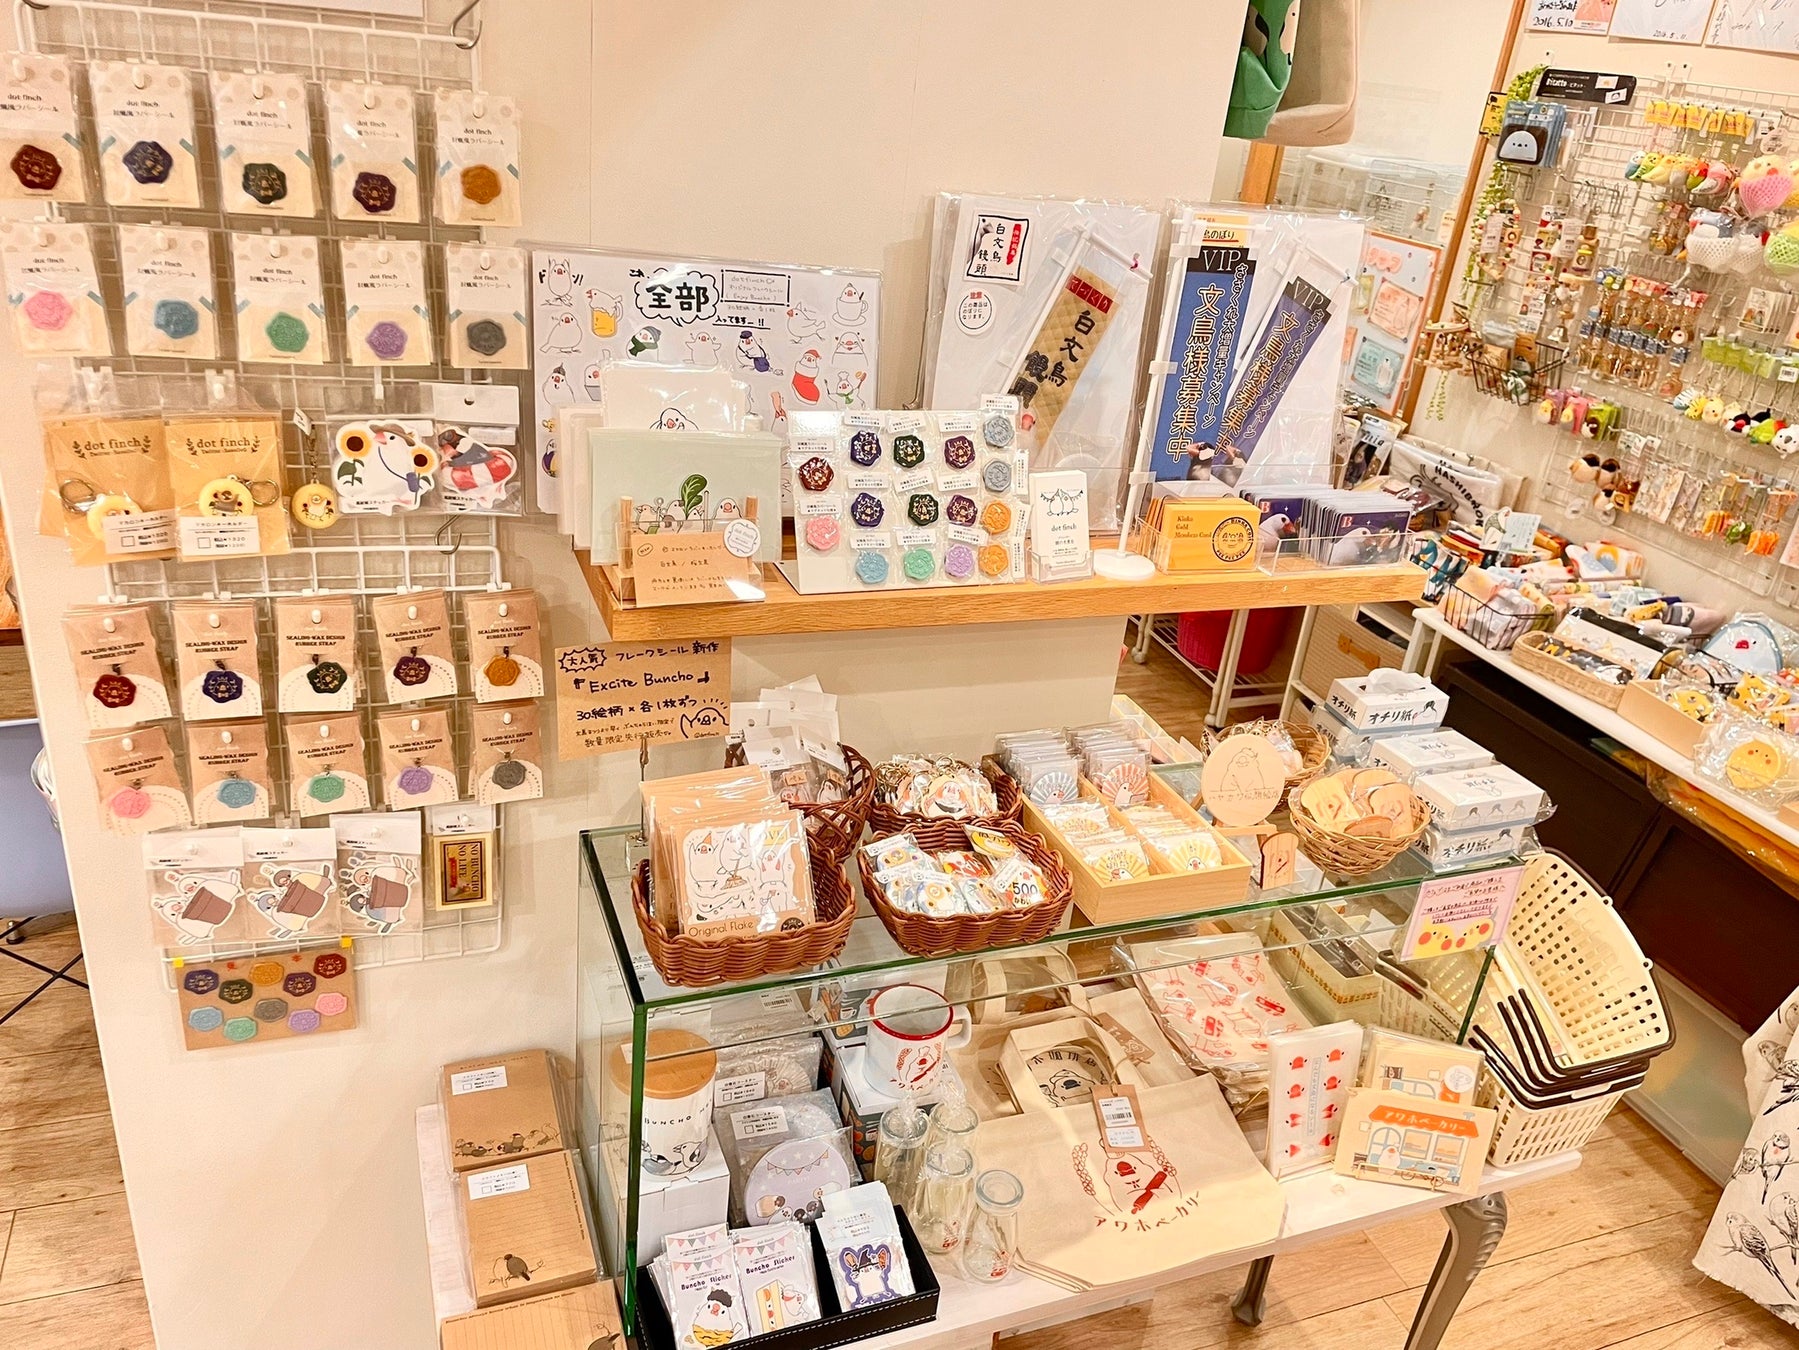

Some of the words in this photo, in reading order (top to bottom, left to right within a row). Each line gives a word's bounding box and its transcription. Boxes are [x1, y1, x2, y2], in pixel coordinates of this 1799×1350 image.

[1202, 249, 1242, 272] VIP
[646, 281, 710, 313] 全部
[1291, 282, 1326, 310] VIP
[1166, 283, 1226, 464] 文鳥様募集中
[1213, 310, 1301, 456] 文鳥様募集中
[84, 439, 105, 451] dot
[108, 438, 142, 450] finch
[196, 438, 218, 449] dot
[219, 437, 251, 448] finch
[112, 649, 137, 658] STRAP
[567, 653, 600, 667] 大人気
[615, 645, 689, 662] フレークシール
[692, 640, 720, 655] 新作
[1331, 695, 1358, 721] オチリ紙
[1369, 709, 1414, 725] オチリ紙
[459, 844, 466, 857] NO
[471, 843, 479, 856] NO
[459, 858, 467, 878] LIFE
[471, 856, 481, 892] BUNCHO
[1012, 881, 1038, 895] 500
[688, 923, 728, 937] Original
[730, 919, 754, 931] Flake
[644, 1115, 692, 1125] BUNCHO
[1384, 1111, 1466, 1131] アワホベーカリー
[746, 1264, 770, 1274] Buncho
[773, 1255, 795, 1266] Sticker
[681, 1280, 706, 1290] Buncho
[710, 1273, 732, 1283] Sticker
